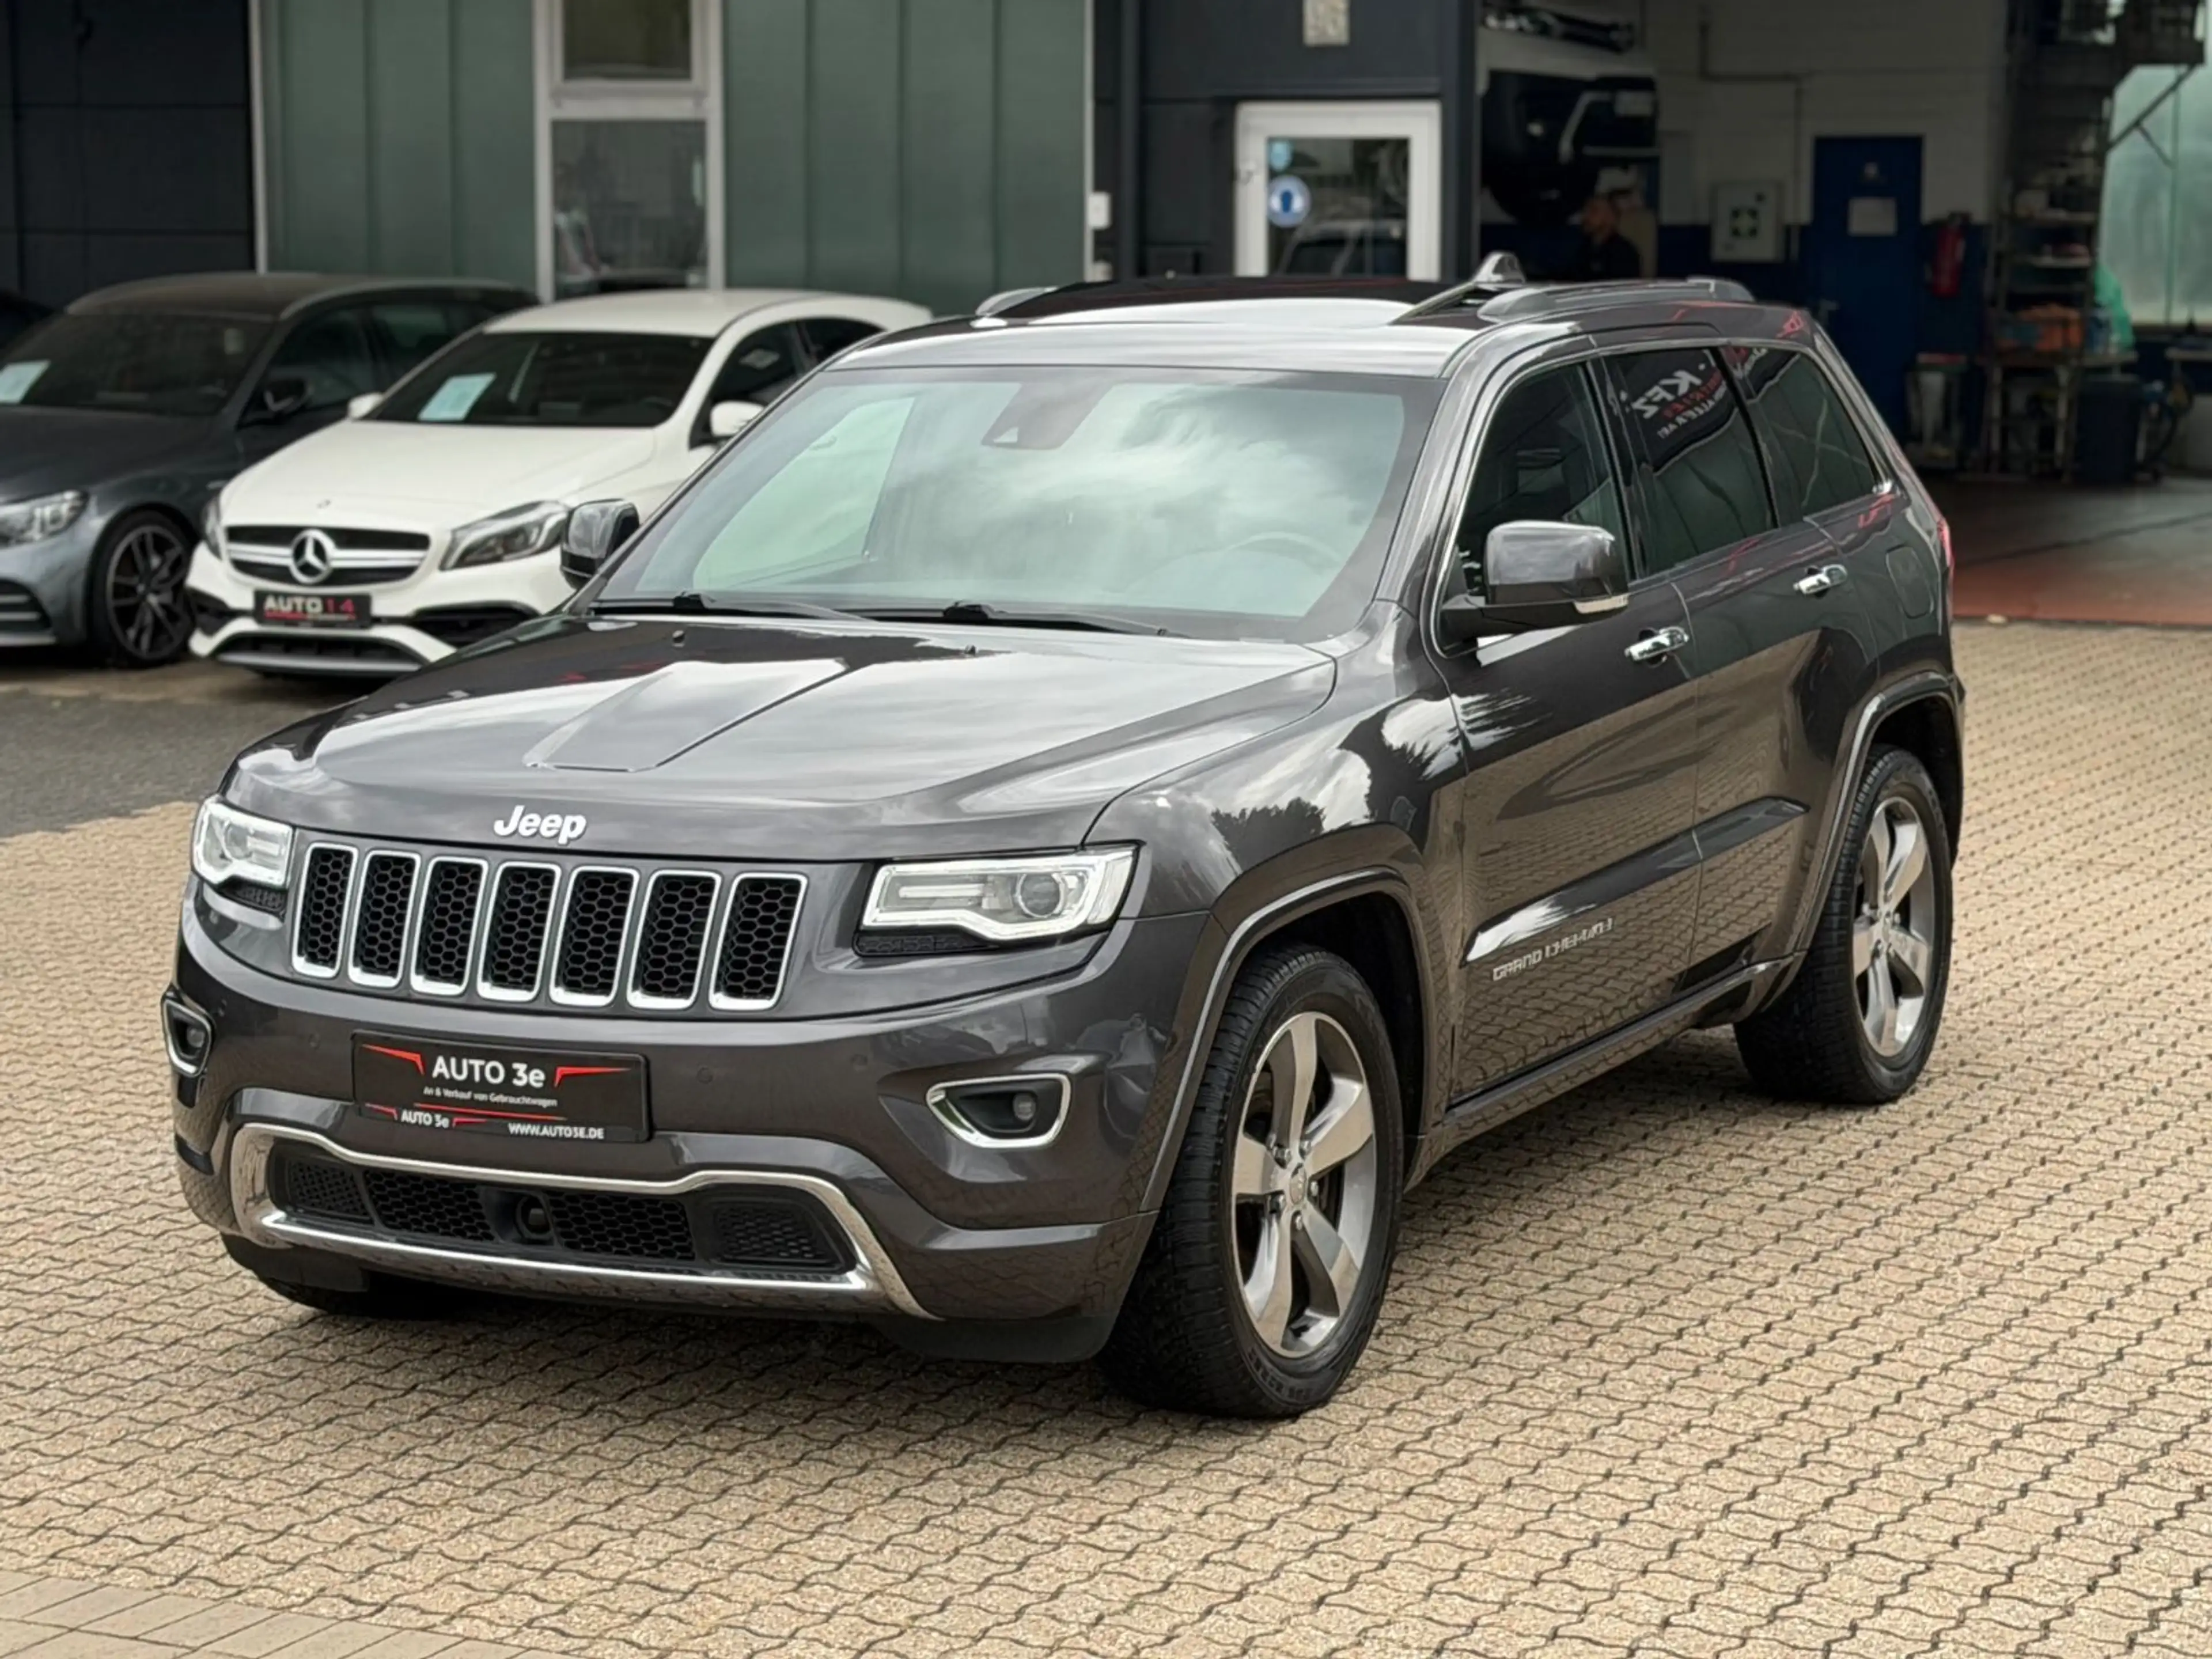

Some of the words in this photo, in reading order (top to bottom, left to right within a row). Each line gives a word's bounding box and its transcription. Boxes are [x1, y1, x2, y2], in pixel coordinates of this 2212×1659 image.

[264, 594, 323, 613] AUTO
[493, 805, 587, 844] Jeep
[1493, 949, 1543, 982] GRAND
[432, 1055, 505, 1084] AUTO
[512, 1062, 546, 1089] 3e
[442, 1088, 472, 1100] Verkauf
[474, 1093, 488, 1101] von
[490, 1092, 558, 1108] Gebrauchtwagen
[401, 1108, 432, 1126] AUTO
[434, 1113, 450, 1129] 3e
[507, 1122, 604, 1140] WWW.AUTO3E.DE
